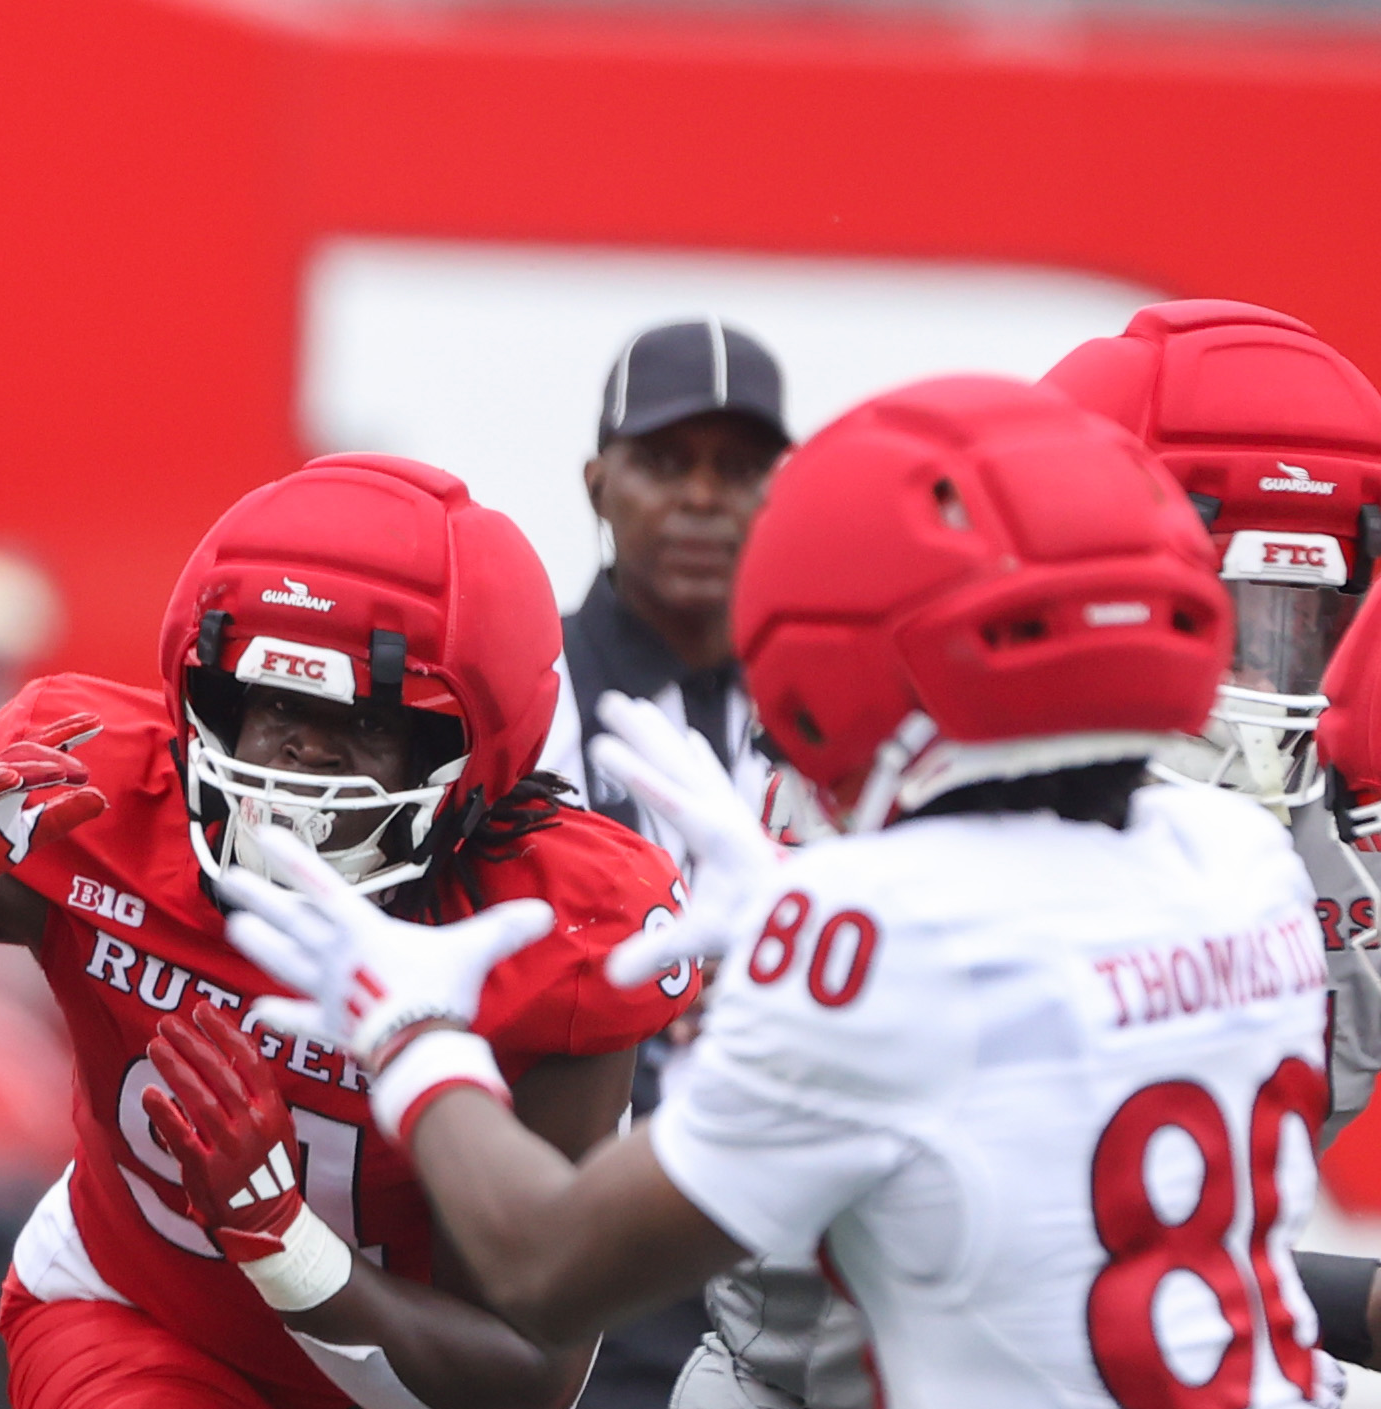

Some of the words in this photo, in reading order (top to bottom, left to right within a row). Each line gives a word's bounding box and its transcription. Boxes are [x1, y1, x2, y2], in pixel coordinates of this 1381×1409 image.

[1258, 477, 1335, 495] GUARDIAN
[261, 588, 332, 613] GUARDIAN
[748, 889, 877, 1008] 80
[1094, 930, 1283, 1027] THOMAS
